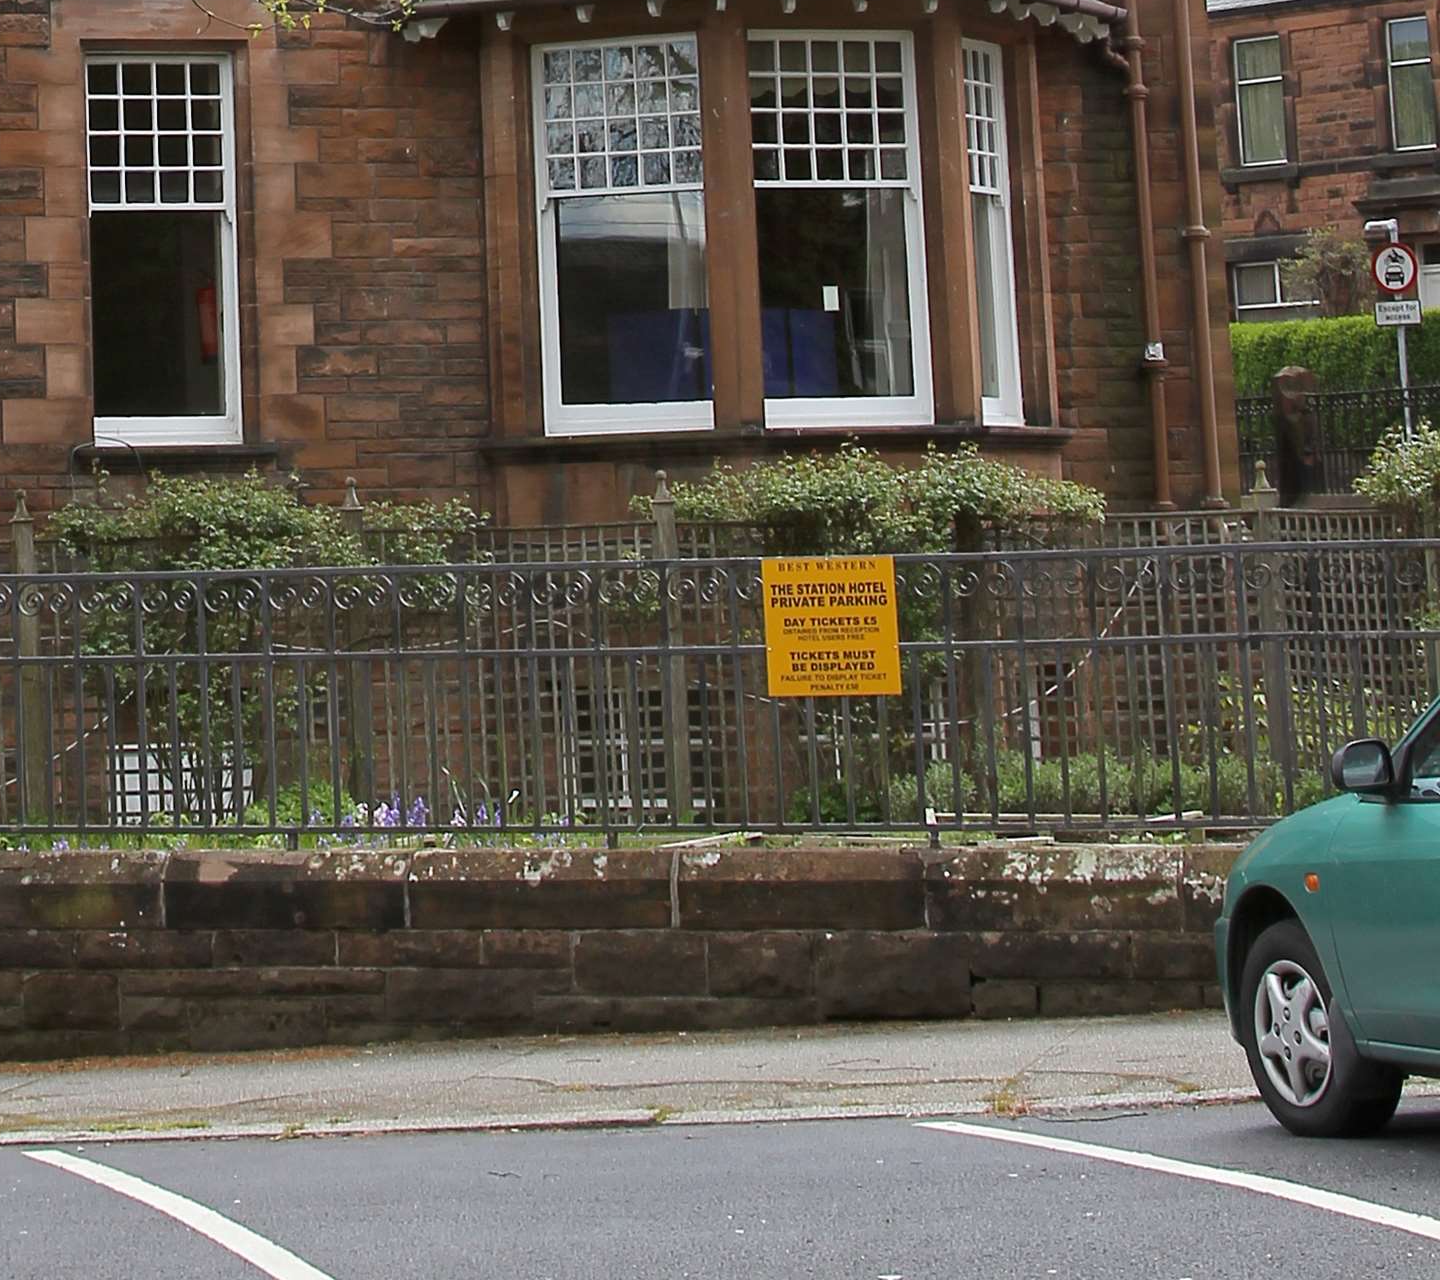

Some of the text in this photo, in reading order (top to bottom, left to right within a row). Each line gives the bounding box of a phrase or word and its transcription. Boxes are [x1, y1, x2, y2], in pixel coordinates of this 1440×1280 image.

[1378, 303, 1417, 313] Except for
[778, 561, 877, 572] BEST WESTERN
[770, 582, 887, 595] THE STATION HOTEL
[771, 595, 887, 608] PRIVATE PARKING
[784, 616, 877, 627] DAY TICKETS £5
[789, 650, 876, 661] TICKETS MUST
[792, 662, 875, 672] BE DISPLAYED
